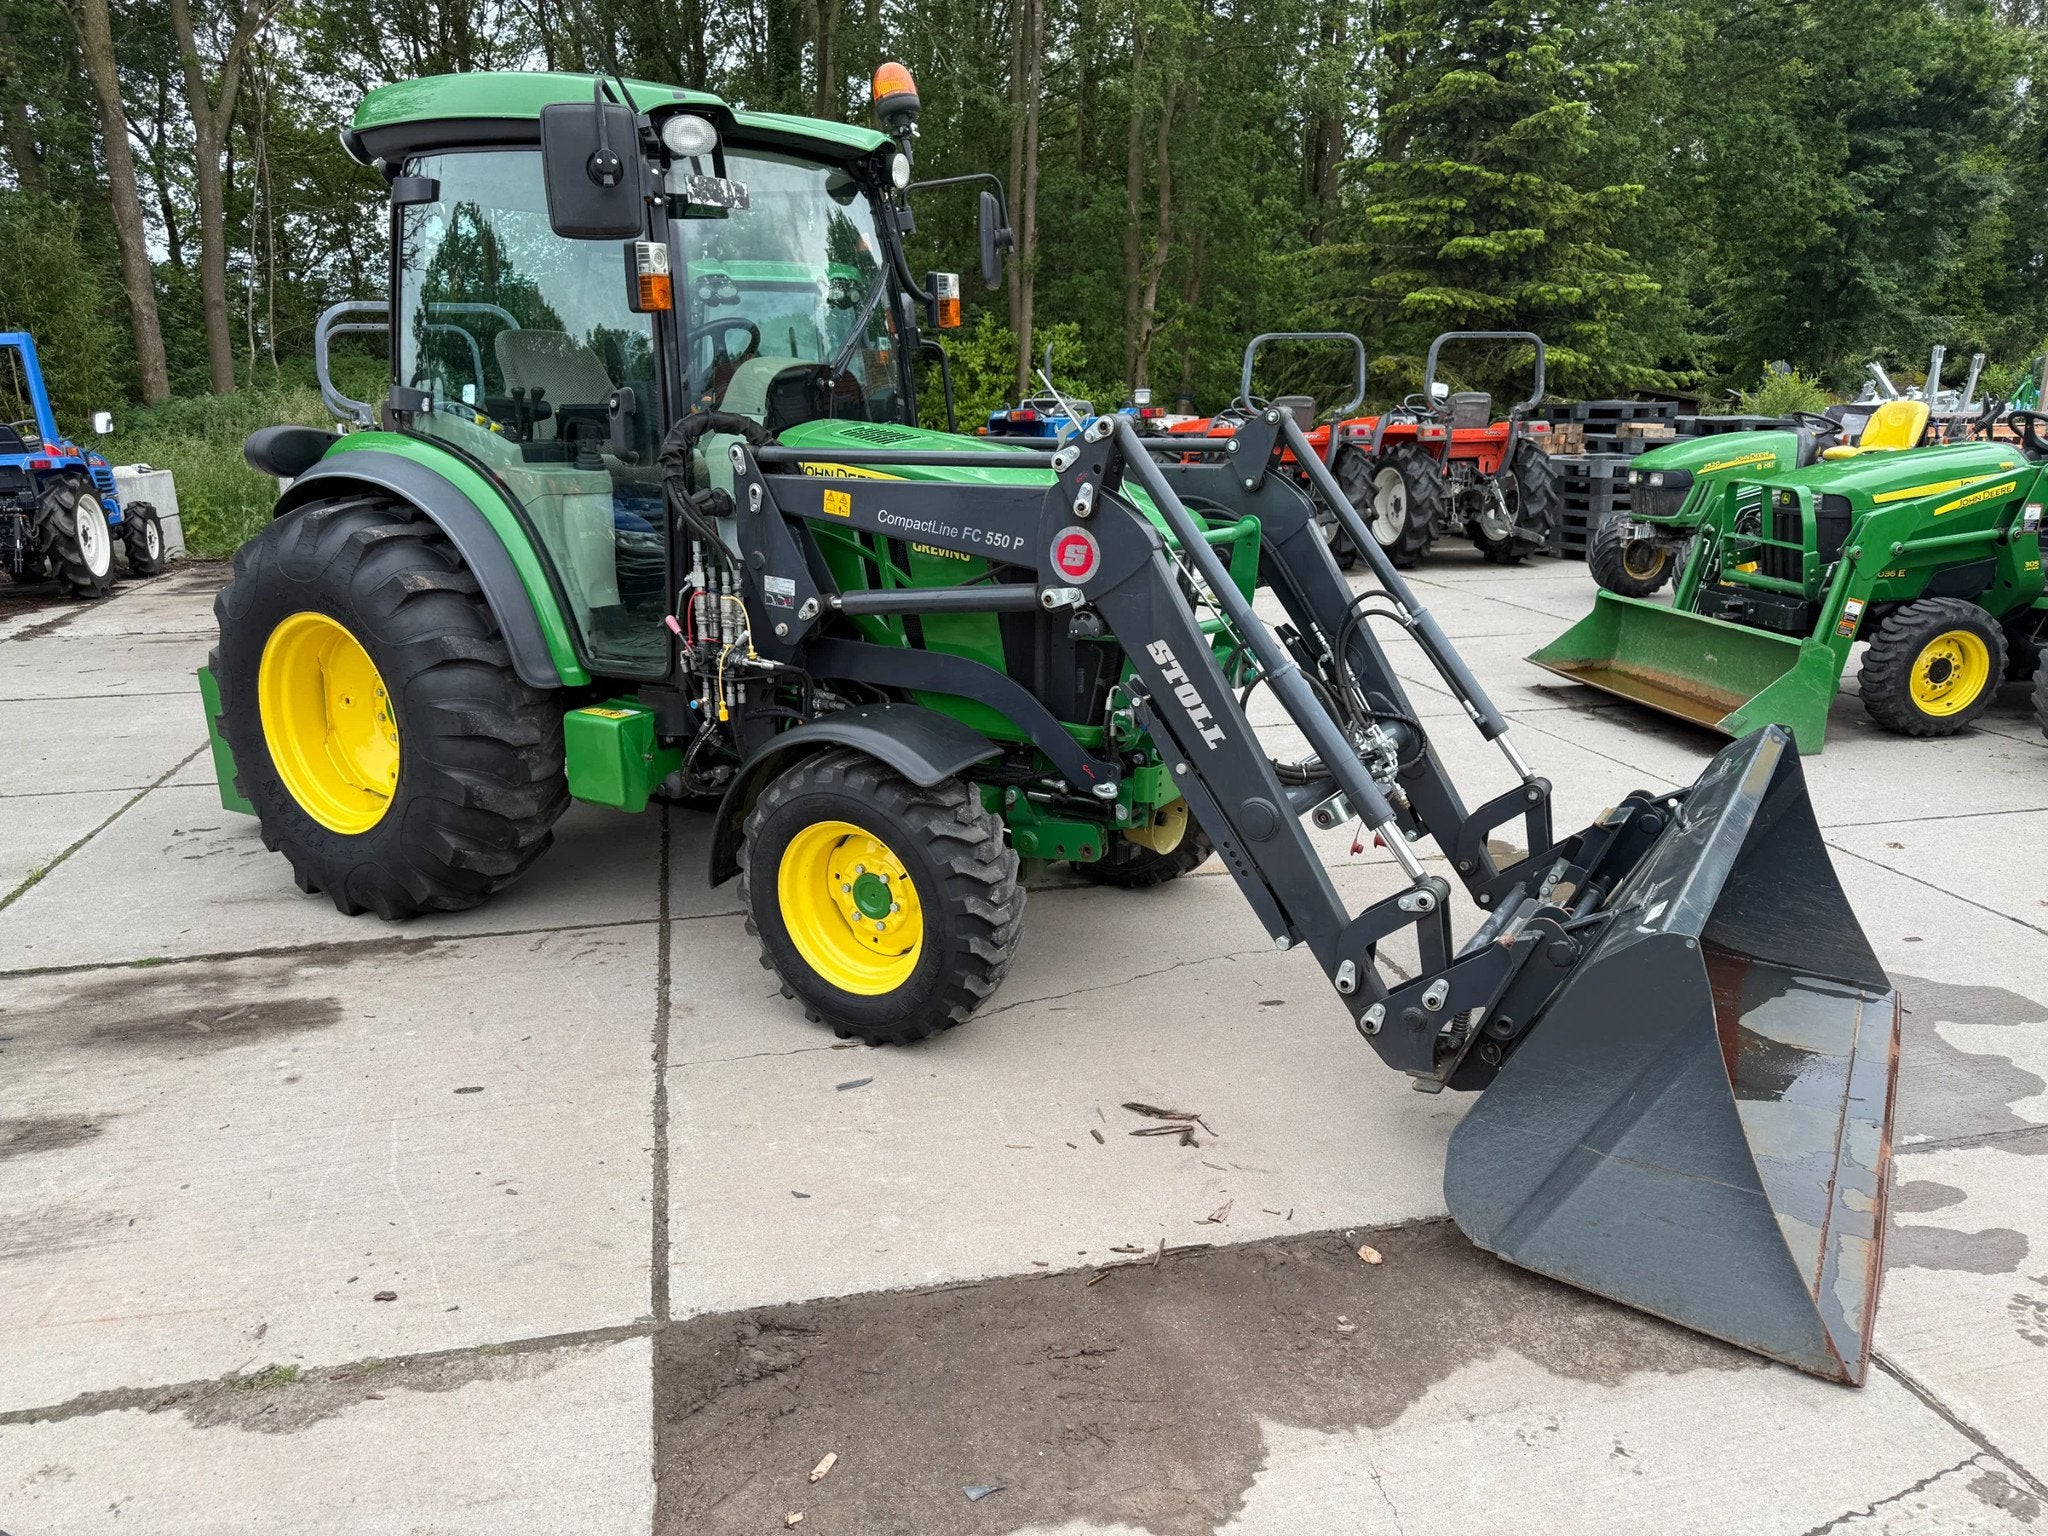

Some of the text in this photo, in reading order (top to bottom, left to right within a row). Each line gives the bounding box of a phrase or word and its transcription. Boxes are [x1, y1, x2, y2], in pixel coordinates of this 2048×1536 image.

[1958, 485, 2012, 508] JOHN DEERE
[878, 509, 1025, 550] CompactLine FC 550 P
[1145, 639, 1227, 751] STOLL
